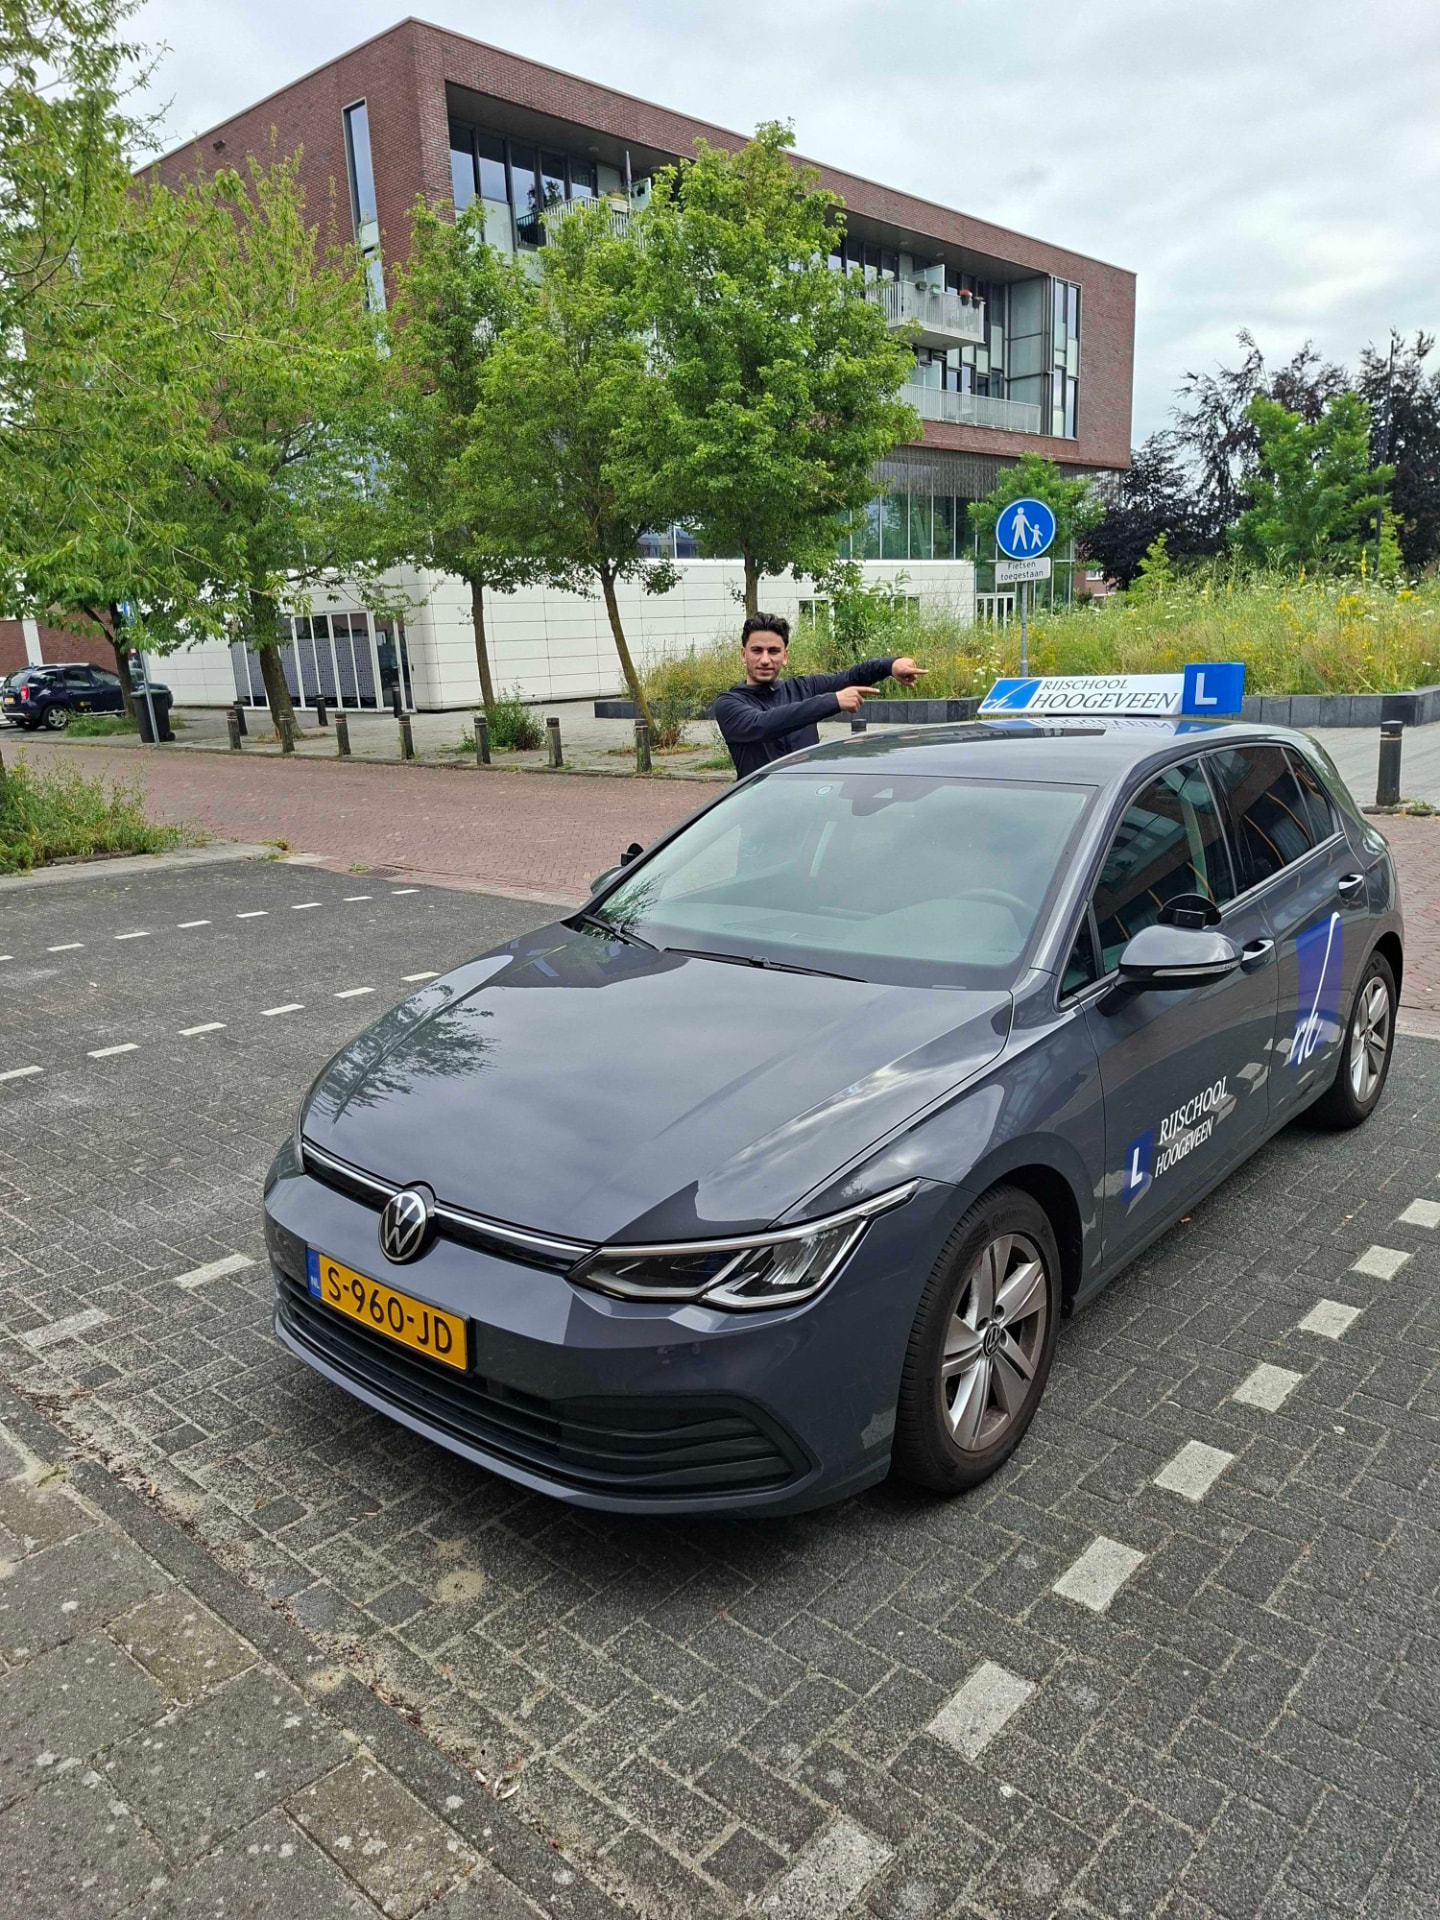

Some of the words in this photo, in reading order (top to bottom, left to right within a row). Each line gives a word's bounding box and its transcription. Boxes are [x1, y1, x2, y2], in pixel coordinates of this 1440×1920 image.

[1000, 570, 1044, 581] toegestaan
[1007, 561, 1036, 570] Fietsen
[1041, 679, 1128, 691] RIJSCHOOL
[1194, 672, 1218, 705] L
[1029, 692, 1180, 710] HOOGEVEEN
[1158, 1075, 1228, 1146] RIJSCHOOL
[1154, 1115, 1214, 1178] HOOGEVEEN
[1130, 1146, 1143, 1189] L
[310, 1275, 320, 1289] NL
[327, 1266, 453, 1354] S-960-JD
